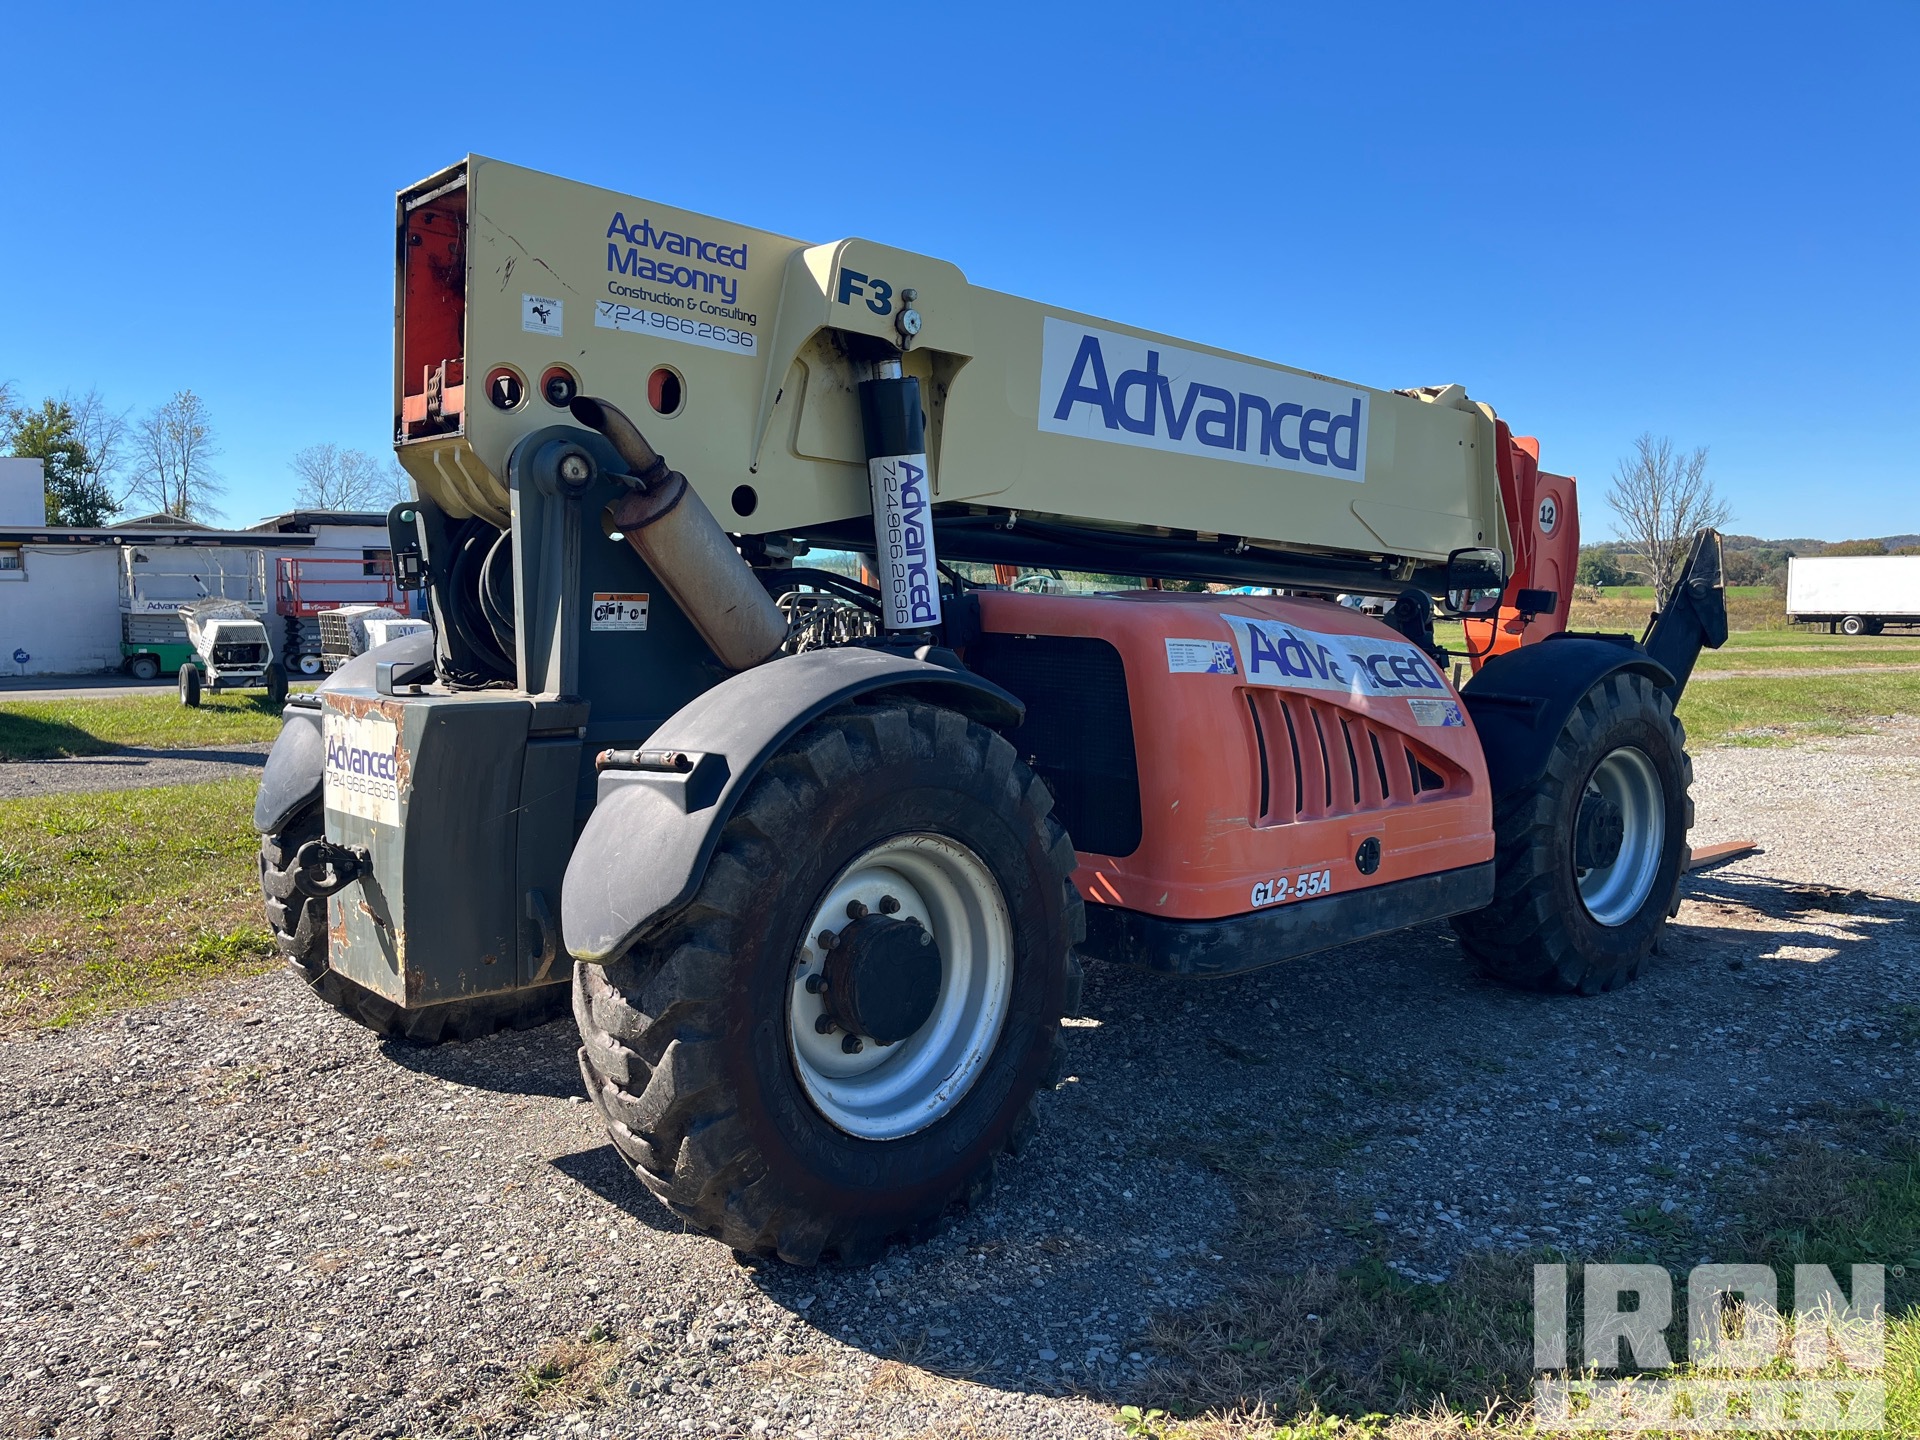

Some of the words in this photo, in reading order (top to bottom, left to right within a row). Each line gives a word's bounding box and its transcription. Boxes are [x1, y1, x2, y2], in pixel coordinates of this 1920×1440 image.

[607, 212, 747, 270] Advanced
[607, 243, 737, 305] Masonry
[838, 267, 893, 316] F3
[601, 301, 754, 347] 724.966.2636
[608, 281, 684, 308] Construction
[687, 298, 697, 310] &
[700, 301, 757, 326] Consulting
[1053, 334, 1361, 472] Advanced
[1540, 505, 1554, 524] 12
[883, 461, 909, 624] 724.966.2636
[898, 460, 936, 624] Advanced
[327, 735, 396, 781] Advanced
[1251, 869, 1330, 907] G12-55A
